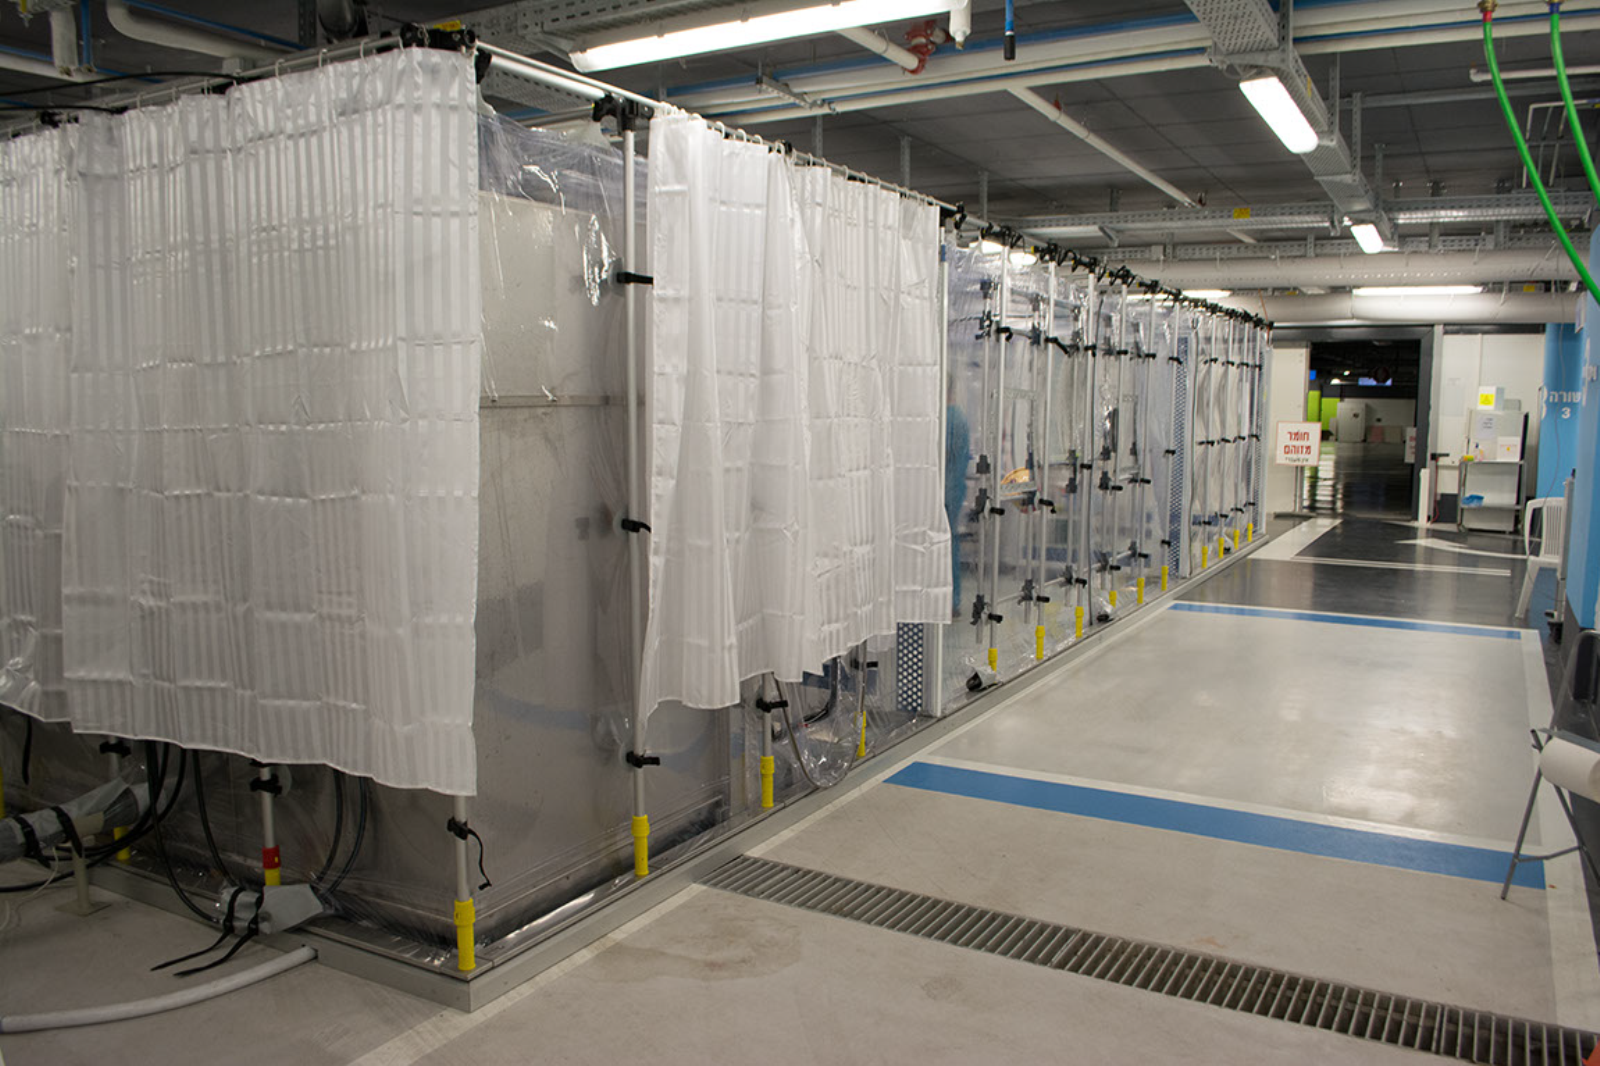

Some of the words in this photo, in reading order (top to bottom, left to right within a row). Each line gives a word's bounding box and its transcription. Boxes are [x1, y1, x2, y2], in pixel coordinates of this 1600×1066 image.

[1550, 391, 1581, 403] שורה
[1561, 407, 1571, 419] 3
[1287, 431, 1310, 441] חומר
[1284, 445, 1311, 455] מזוהם
